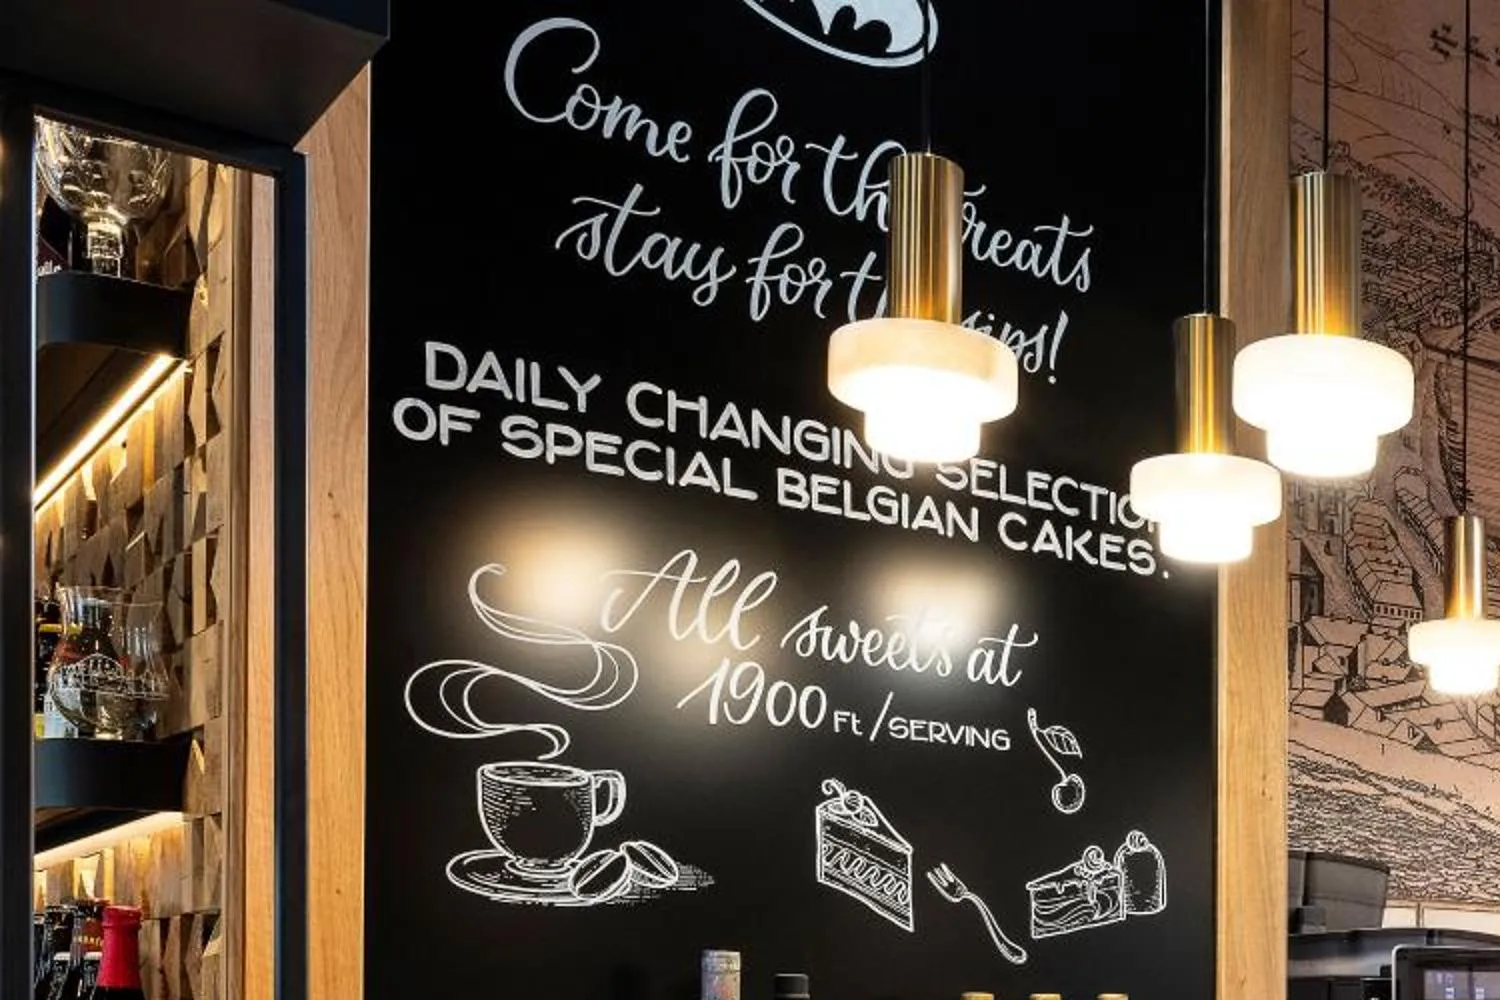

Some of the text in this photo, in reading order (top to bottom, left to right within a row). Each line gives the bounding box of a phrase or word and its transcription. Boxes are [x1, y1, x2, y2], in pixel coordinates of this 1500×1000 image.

[503, 16, 693, 164] Come
[707, 87, 801, 210] for
[804, 134, 907, 233] th
[961, 183, 1095, 294] reats
[554, 183, 738, 307] stay
[745, 221, 834, 322] for
[391, 396, 1170, 580] OF SPECIAL BELGIAN CAKES.
[424, 340, 602, 414] DAILY
[935, 455, 1154, 534] SELECTIO
[599, 548, 1039, 688] All sweets at
[676, 656, 828, 729] 1900
[833, 710, 863, 737] Ft
